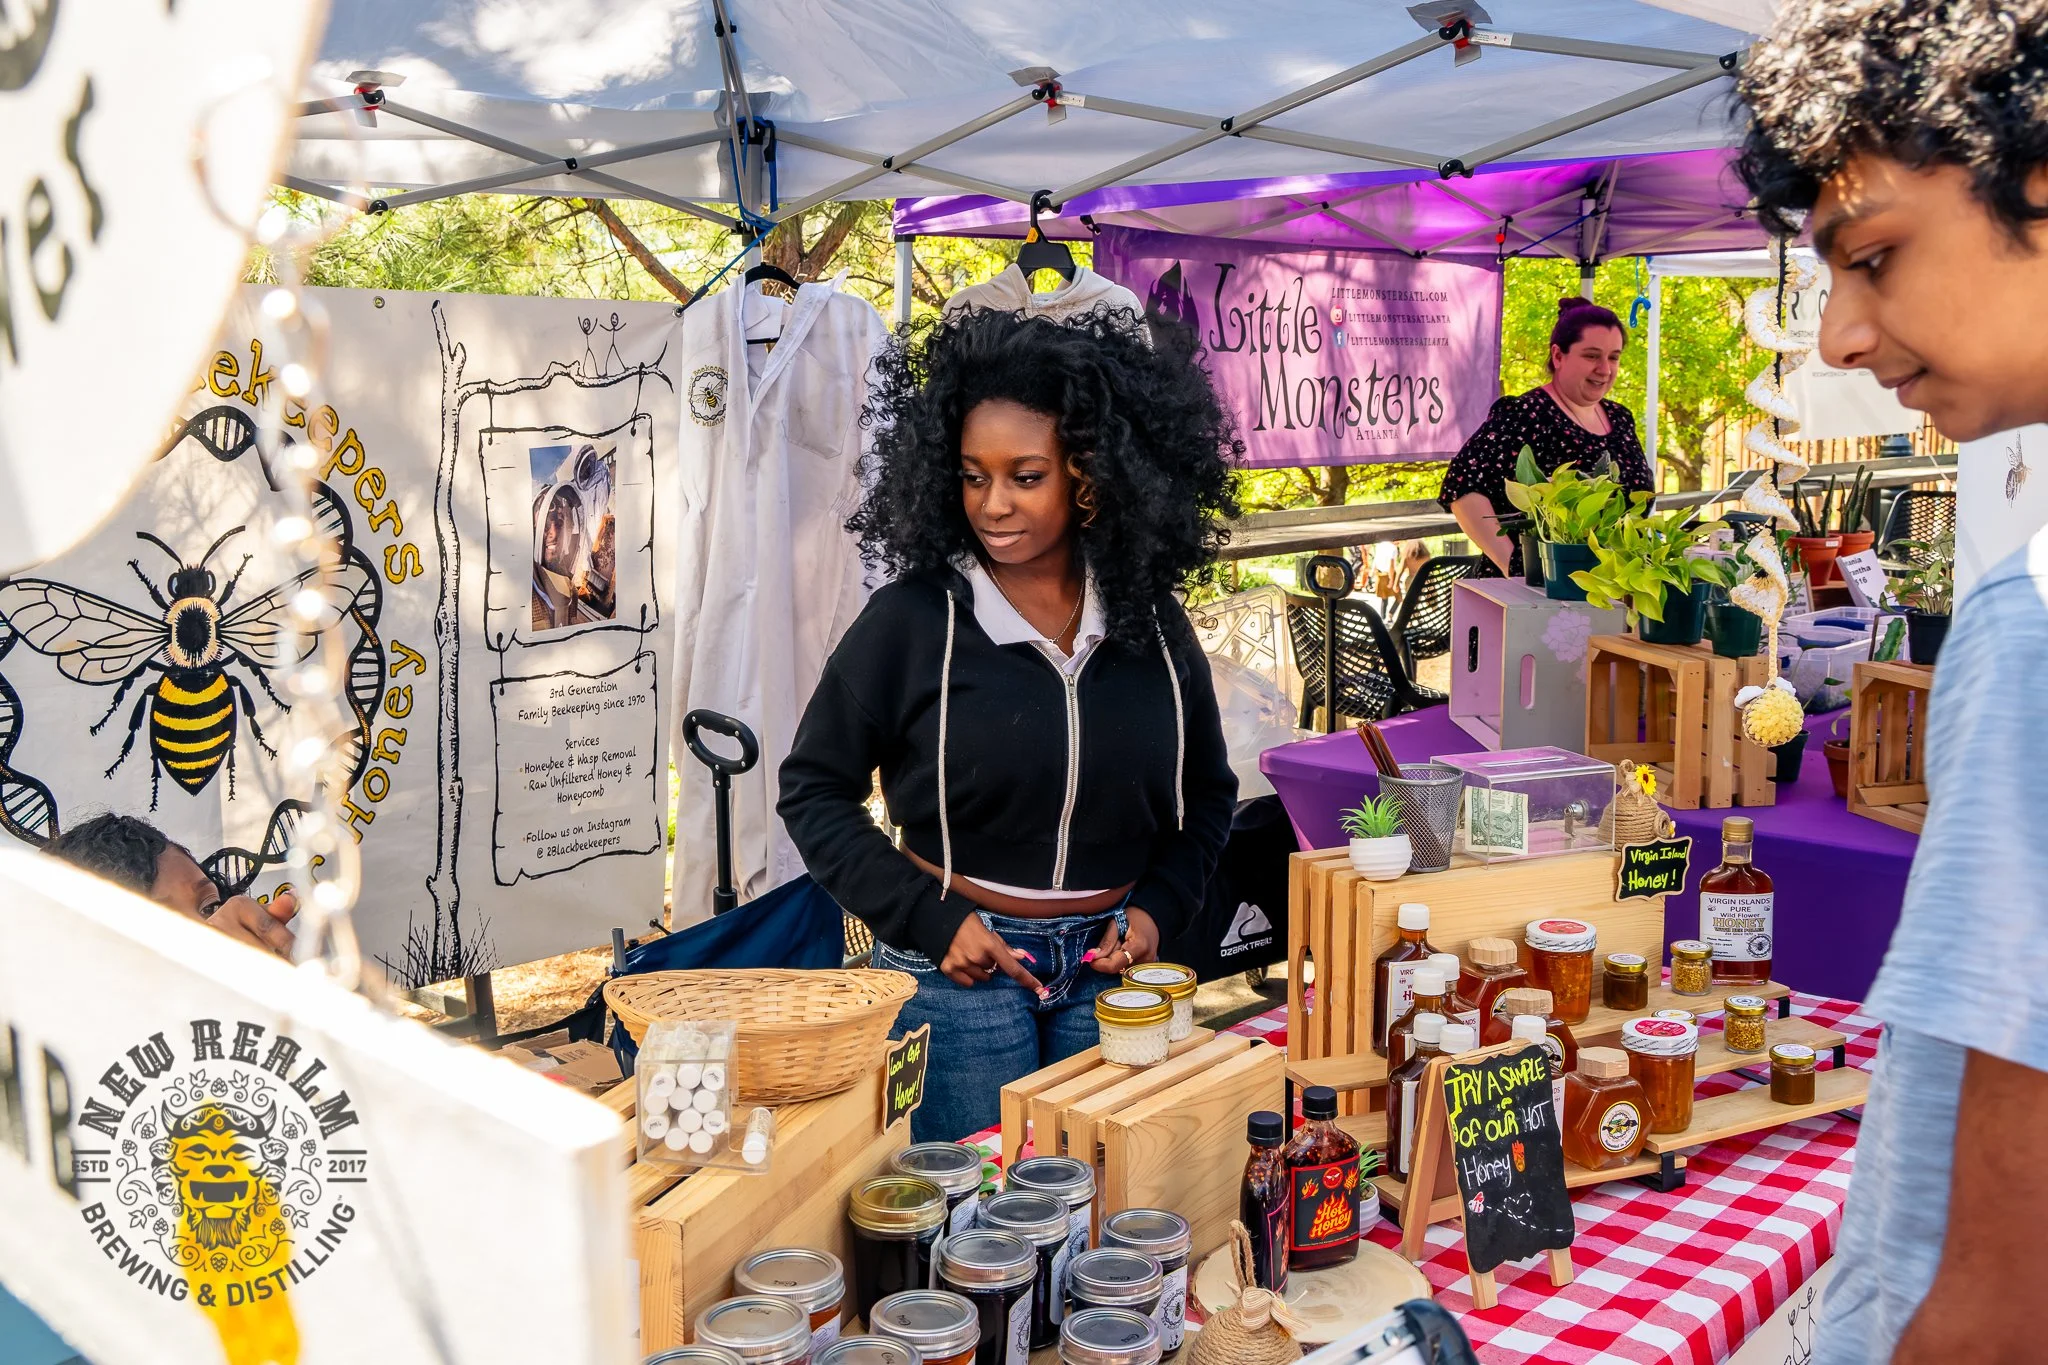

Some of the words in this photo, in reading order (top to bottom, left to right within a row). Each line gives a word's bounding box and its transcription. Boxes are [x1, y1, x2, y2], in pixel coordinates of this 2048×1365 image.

[1331, 287, 1448, 302] LITTLEMONSTERSATL.COM
[1209, 263, 1323, 358] Little
[1253, 351, 1444, 439] Monsters
[549, 685, 565, 698] 3rd
[568, 681, 618, 696] Generation
[518, 708, 548, 724] Family
[551, 701, 600, 719] Beekeeping
[603, 699, 625, 710] since
[628, 694, 646, 707] 1970
[336, 640, 426, 845] Honey
[566, 737, 600, 750] Services
[524, 757, 565, 777] Honeybee
[568, 753, 575, 768] &
[577, 753, 599, 770] Wasp
[602, 746, 637, 763] Removal
[528, 780, 547, 791] Raw
[550, 769, 594, 790] Unfiltered
[597, 769, 622, 783] Honey
[625, 762, 632, 777] &
[557, 784, 605, 806] Honeycomb
[526, 829, 557, 843] Follow
[560, 827, 570, 838] us
[572, 824, 584, 834] on
[587, 816, 632, 833] Instagram
[536, 848, 544, 859] @
[547, 835, 621, 855] 2Blackbeekeepers
[1631, 848, 1658, 865] Virgin
[1660, 846, 1688, 859] Island
[1713, 917, 1766, 928] HONEY
[1220, 943, 1249, 957] OZARK
[890, 1051, 906, 1076] Local
[1444, 1065, 1483, 1115] TRY
[1487, 1071, 1503, 1100] A
[1500, 1057, 1546, 1092] SAMPLE
[1522, 1100, 1551, 1132] HOT
[1462, 1153, 1513, 1190] Honey
[1311, 1208, 1352, 1238] Honey
[1314, 1201, 1346, 1224] Hot
